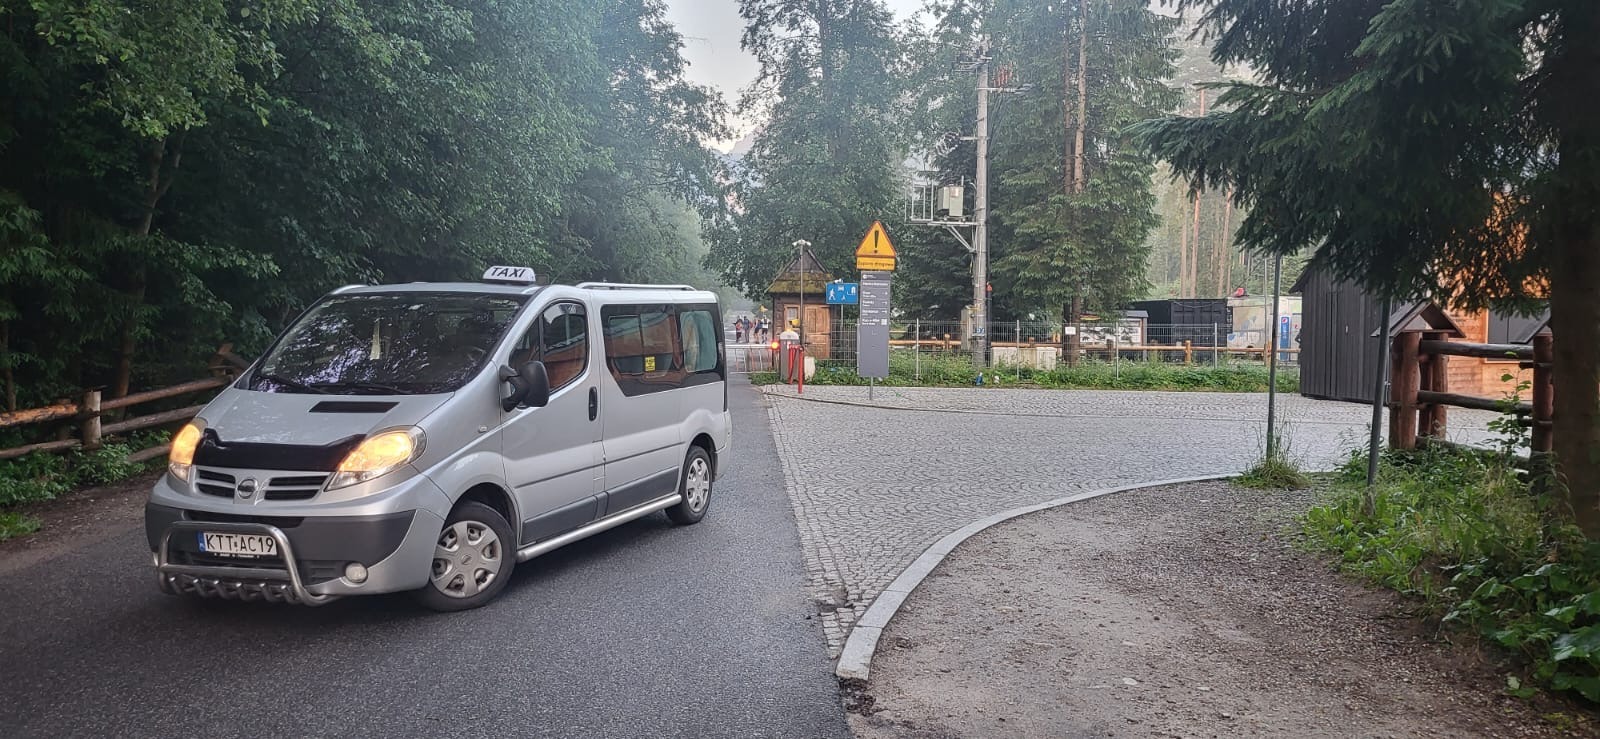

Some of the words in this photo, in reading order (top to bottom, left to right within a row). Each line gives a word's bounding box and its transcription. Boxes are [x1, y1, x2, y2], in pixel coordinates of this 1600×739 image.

[491, 267, 527, 278] TAXI
[205, 533, 234, 551] KTT
[240, 535, 275, 553] AC19
